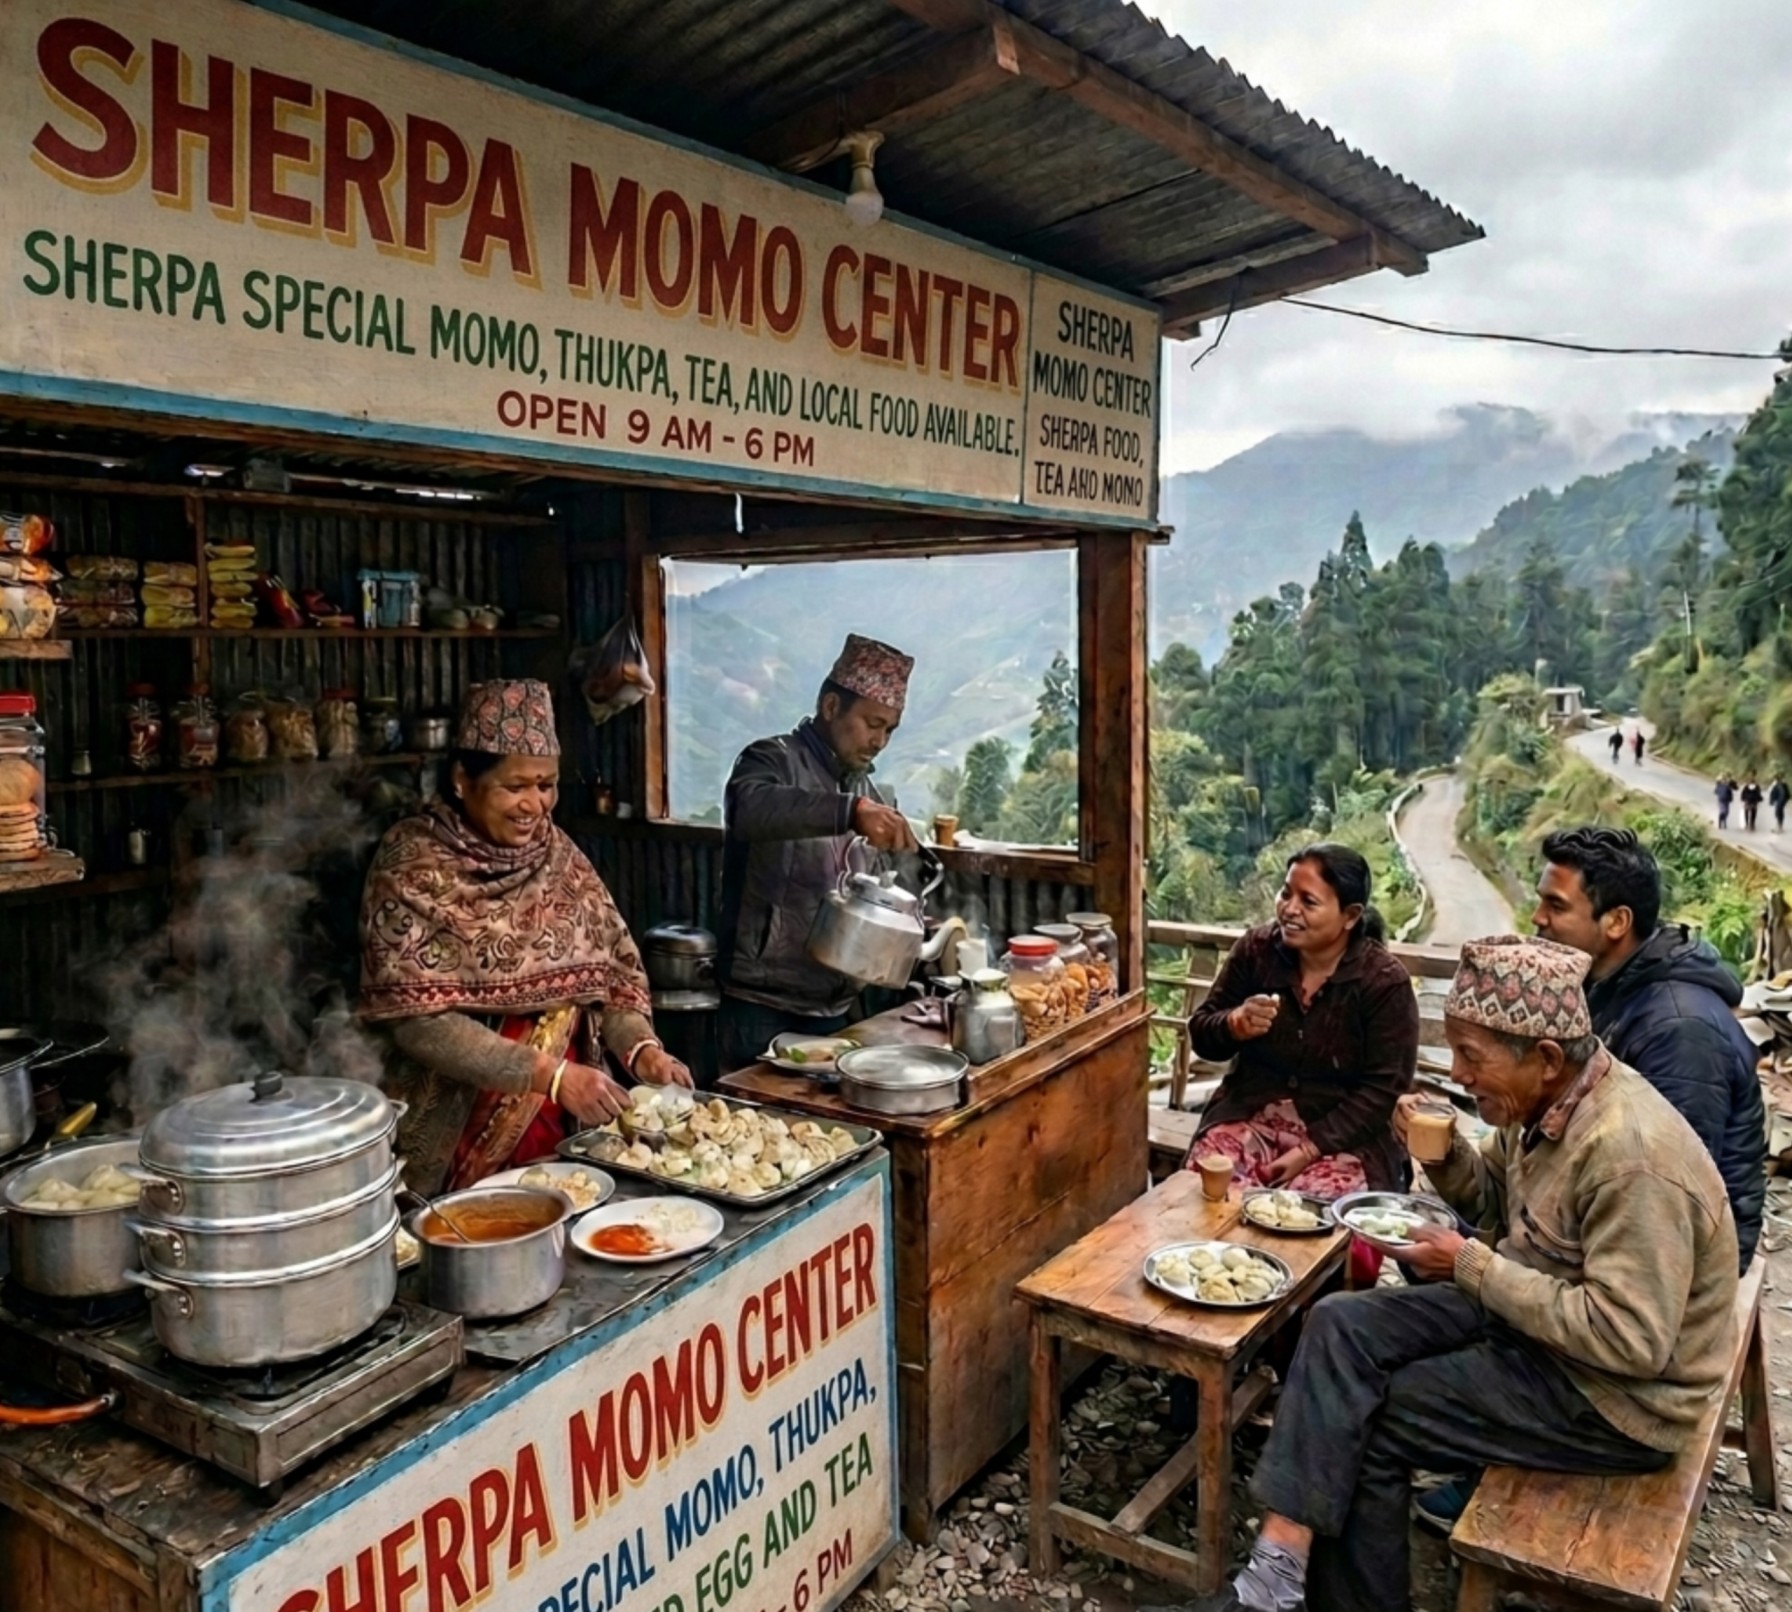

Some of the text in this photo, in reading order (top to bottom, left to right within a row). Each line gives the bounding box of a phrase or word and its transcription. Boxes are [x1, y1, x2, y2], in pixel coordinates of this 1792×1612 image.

[32, 17, 1022, 391] SHERPA MOMO CENTER
[22, 229, 1020, 458] SHERPA SPECIAL MOMO, THUKPA, TEA, AND LOCAL FOOD AVAILABLE.
[1057, 300, 1135, 363] SHERPA
[1032, 350, 1152, 419] MOMO CENTER
[497, 389, 606, 440] OPEN
[626, 408, 651, 444] 9
[661, 414, 713, 454] AM
[744, 426, 764, 460] 6
[774, 430, 815, 467] PM
[1039, 413, 1144, 469] SHERPA FOOD,
[1034, 460, 1064, 497] TEA
[568, 1322, 726, 1524] MOMO
[736, 1222, 876, 1394] CENTER
[664, 1444, 764, 1562] MOMO,
[768, 1356, 877, 1474] THUKPA,
[695, 1431, 873, 1612] EGG AND TEA
[793, 1568, 811, 1612] 6
[817, 1528, 853, 1595] PM
